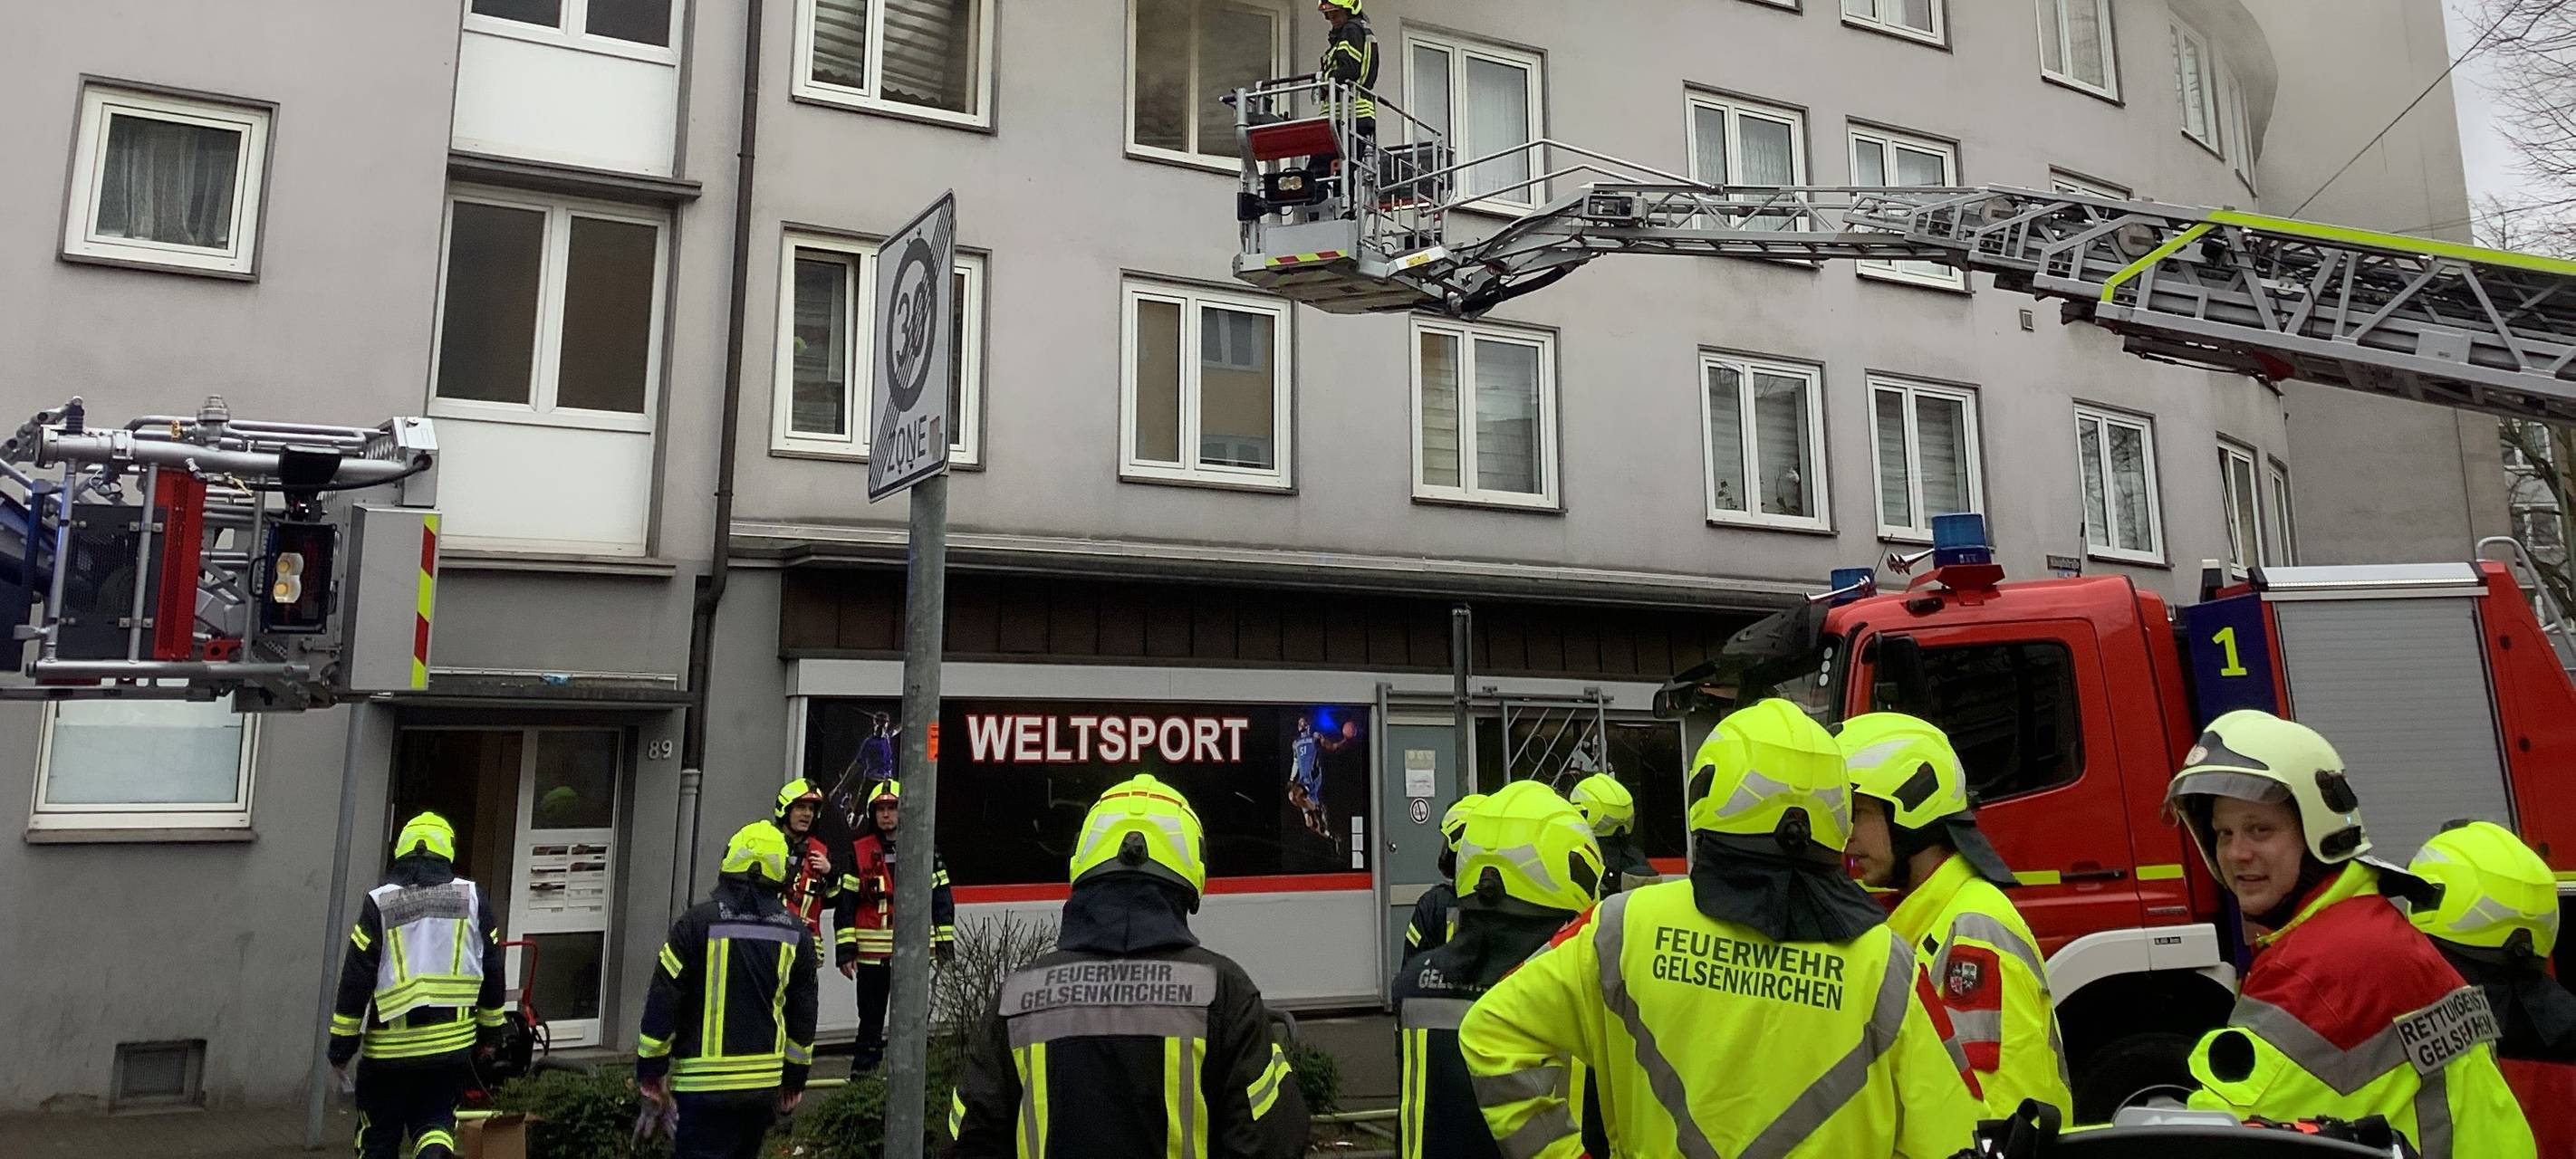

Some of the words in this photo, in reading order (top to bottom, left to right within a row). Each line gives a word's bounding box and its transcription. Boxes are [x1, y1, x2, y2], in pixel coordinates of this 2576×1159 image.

[896, 281, 928, 366] 30
[886, 416, 927, 473] ZONE
[2211, 627, 2247, 676] 1
[649, 740, 672, 759] 89
[966, 715, 1248, 762] WELTSPORT
[1044, 963, 1172, 986] FEUERWEHR
[1655, 926, 1845, 982] FEUERWEHR
[1021, 984, 1193, 1010] GELSENKIRCHEN
[1652, 953, 1843, 1011] GELSENKIRCHEN
